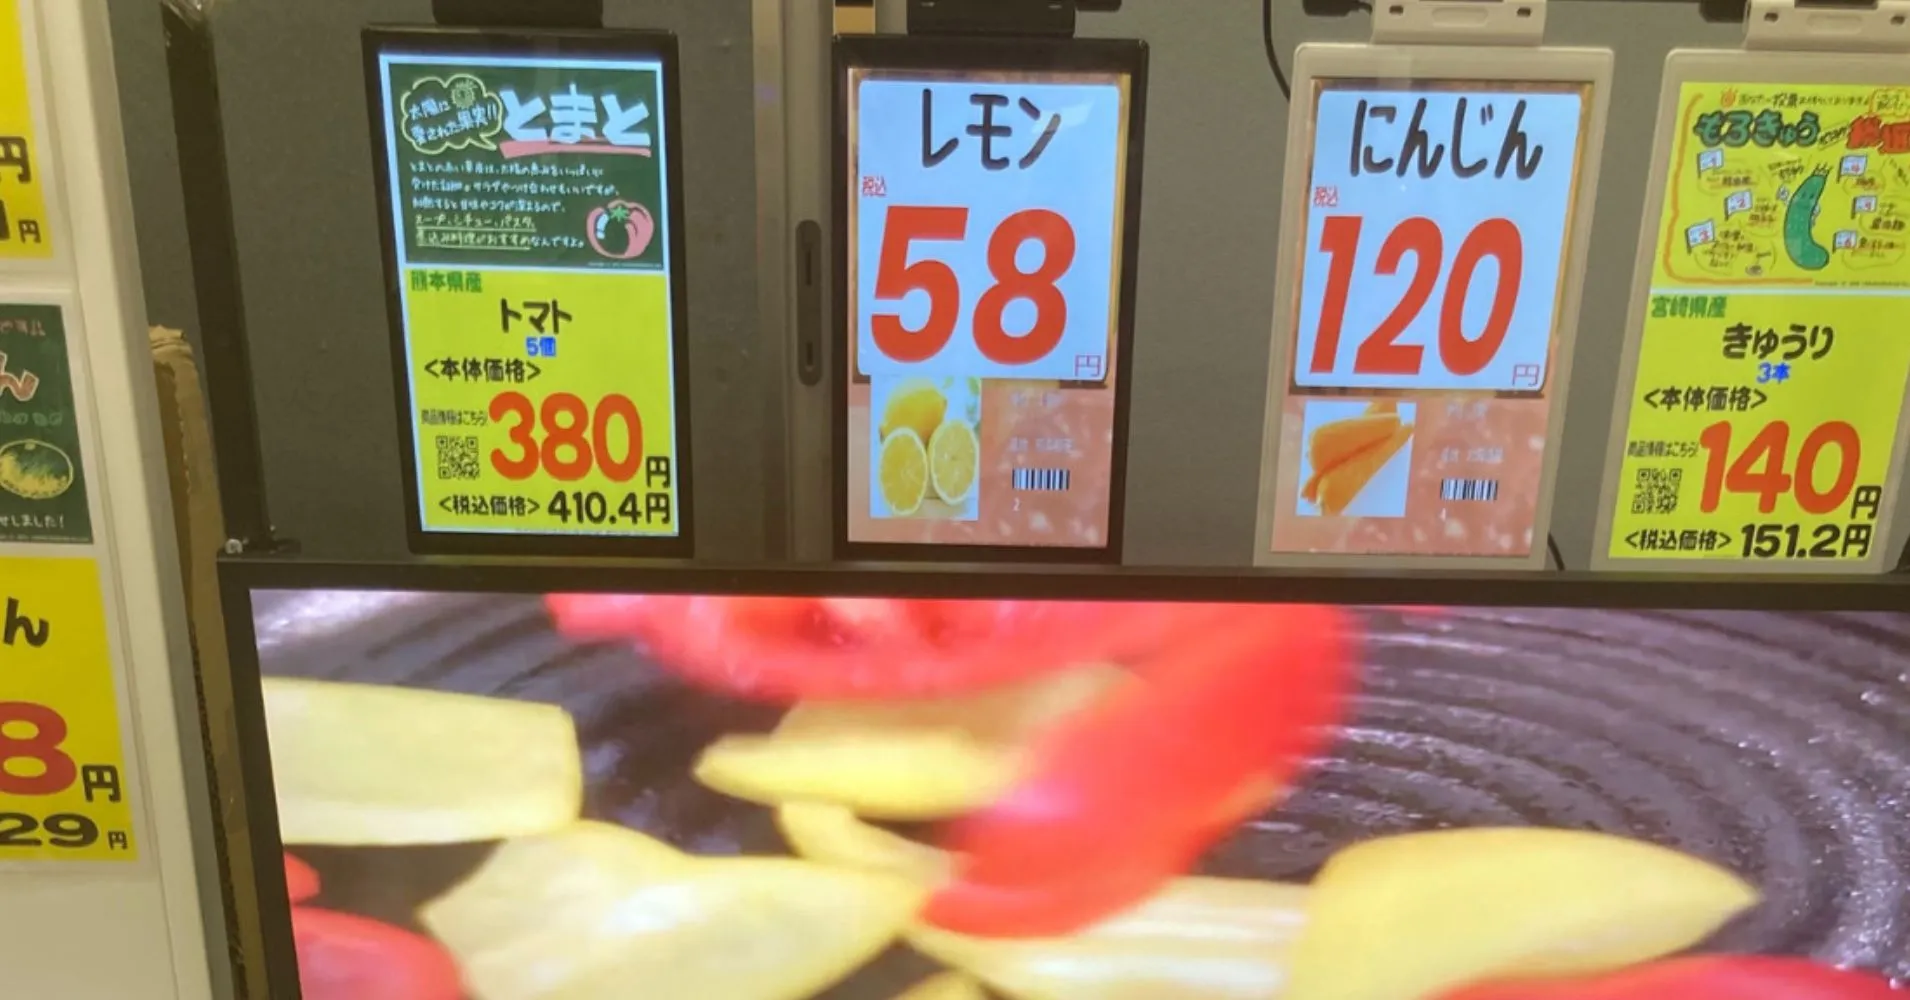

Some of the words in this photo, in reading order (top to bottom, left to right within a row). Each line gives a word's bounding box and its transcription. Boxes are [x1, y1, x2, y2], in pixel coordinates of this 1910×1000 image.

[500, 83, 651, 146] とまと
[922, 88, 1061, 170] レモン
[1349, 97, 1544, 180] にんじん
[411, 271, 483, 293] 熊本県産
[871, 206, 1076, 366] 58
[1074, 354, 1101, 376] 円
[500, 298, 572, 334] トマト
[1310, 215, 1523, 377] 120
[1512, 364, 1541, 387] 円
[1652, 296, 1728, 319] 宮崎県産
[526, 336, 556, 357] 5個
[1722, 322, 1834, 360] きゅうり
[424, 358, 541, 382] <本体価格>
[1756, 362, 1791, 383] 3本
[1643, 386, 1767, 411] <本体価格>
[439, 495, 541, 516] <税込価格>
[547, 490, 671, 524] 410.4円
[1625, 530, 1732, 551] <税込価格>
[1741, 524, 1872, 558] 151.2円
[3, 597, 49, 648] ん
